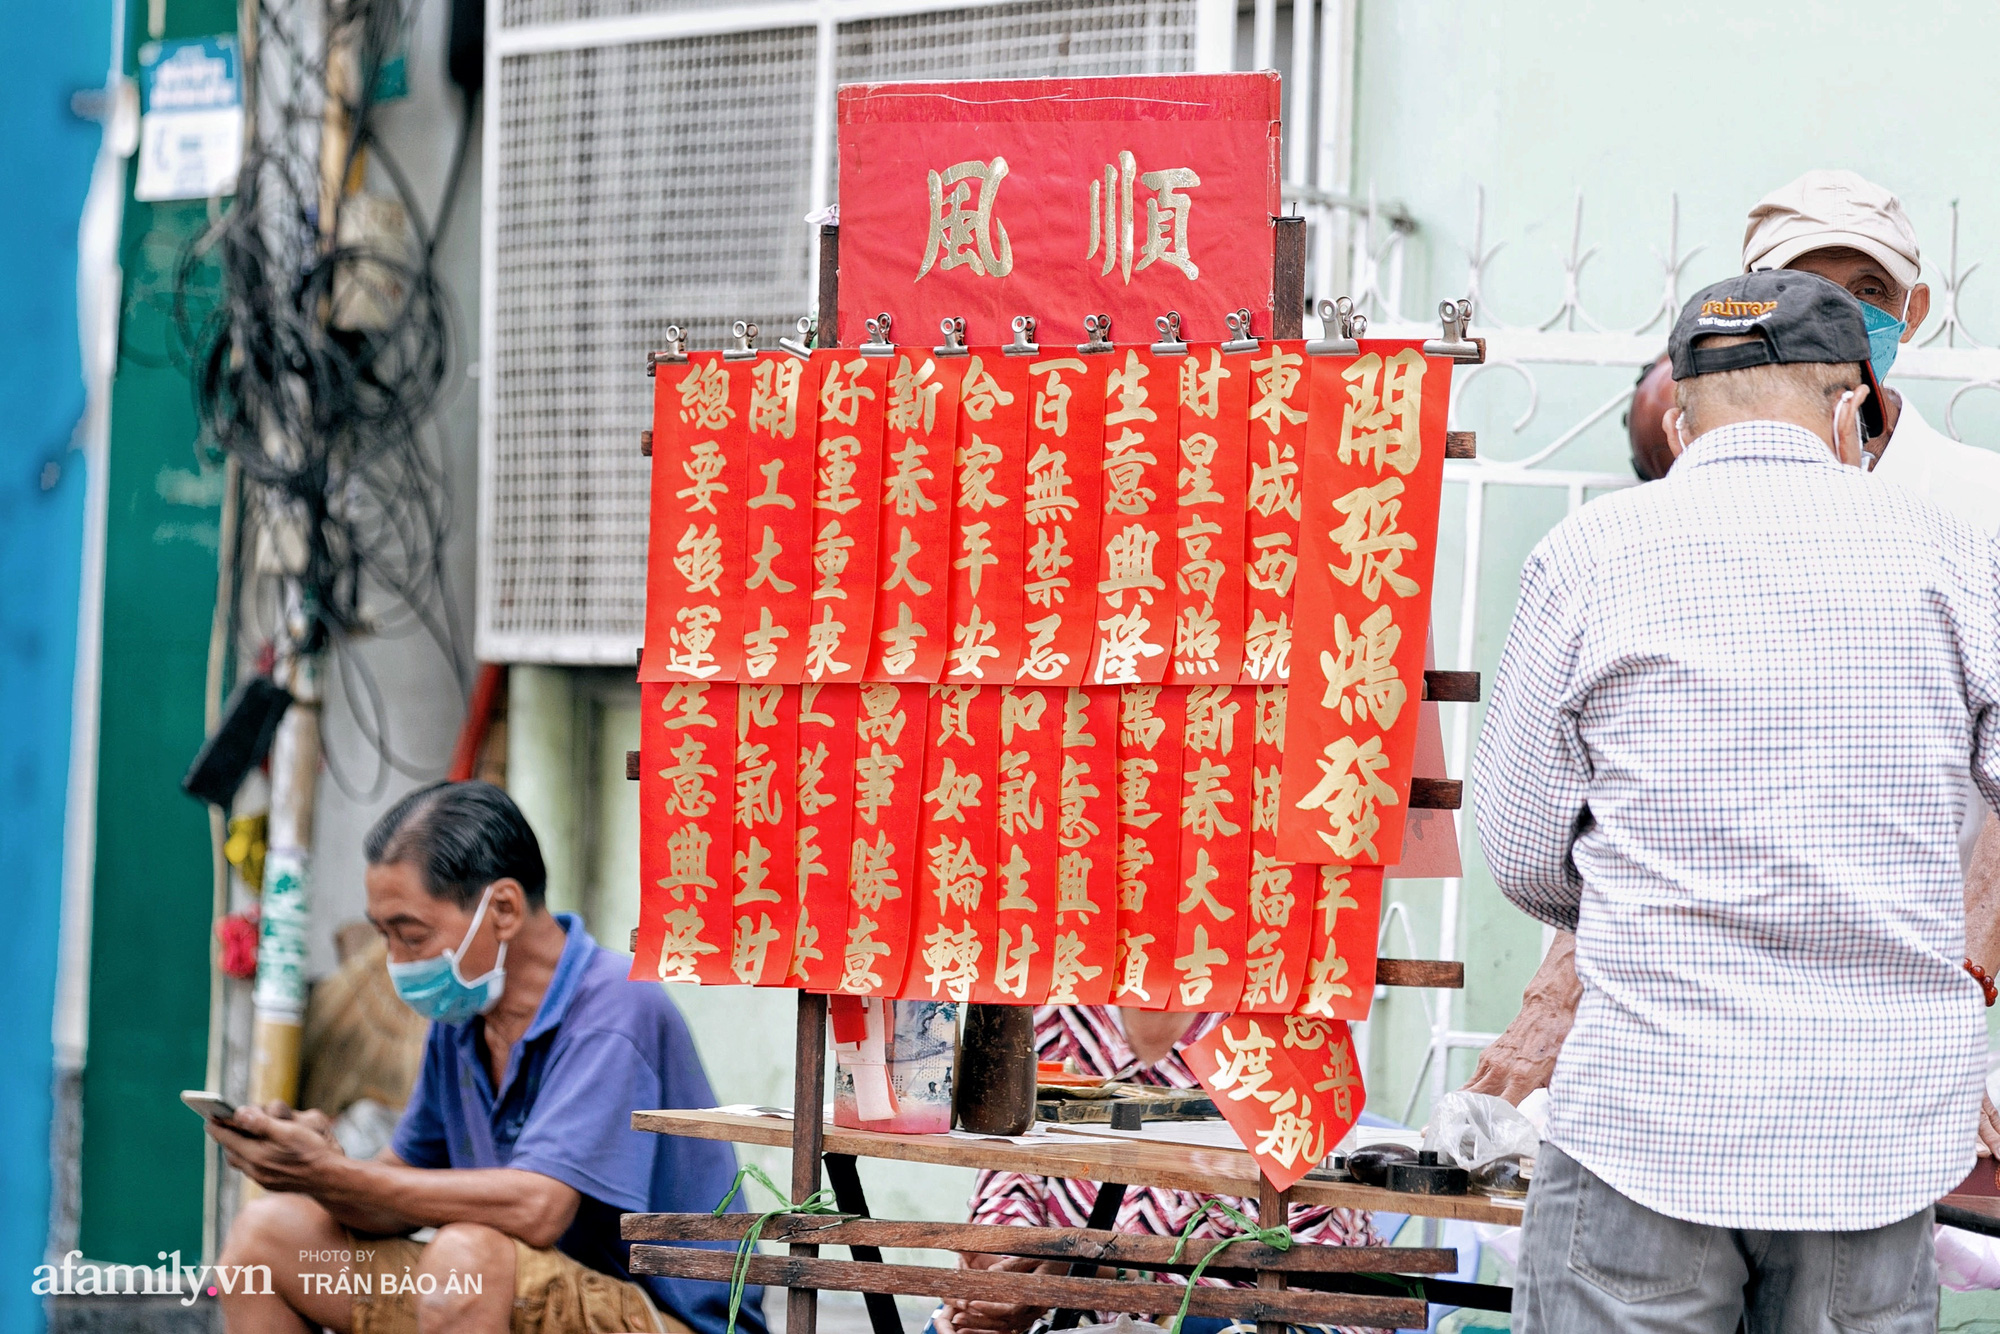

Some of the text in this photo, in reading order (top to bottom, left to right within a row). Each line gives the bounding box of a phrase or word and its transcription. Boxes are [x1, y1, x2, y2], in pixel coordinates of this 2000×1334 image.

[743, 357, 803, 678] 開工大吉
[805, 357, 876, 682] 好運重來
[878, 355, 943, 676] 新春大吉
[947, 356, 1014, 678] 合家平安
[1016, 357, 1088, 681] 百無禁忌
[1093, 349, 1166, 684] 生意興隆
[1176, 348, 1231, 675] 財星高照
[1242, 344, 1308, 681] 東成西就
[1295, 347, 1428, 864] 開張鴻發
